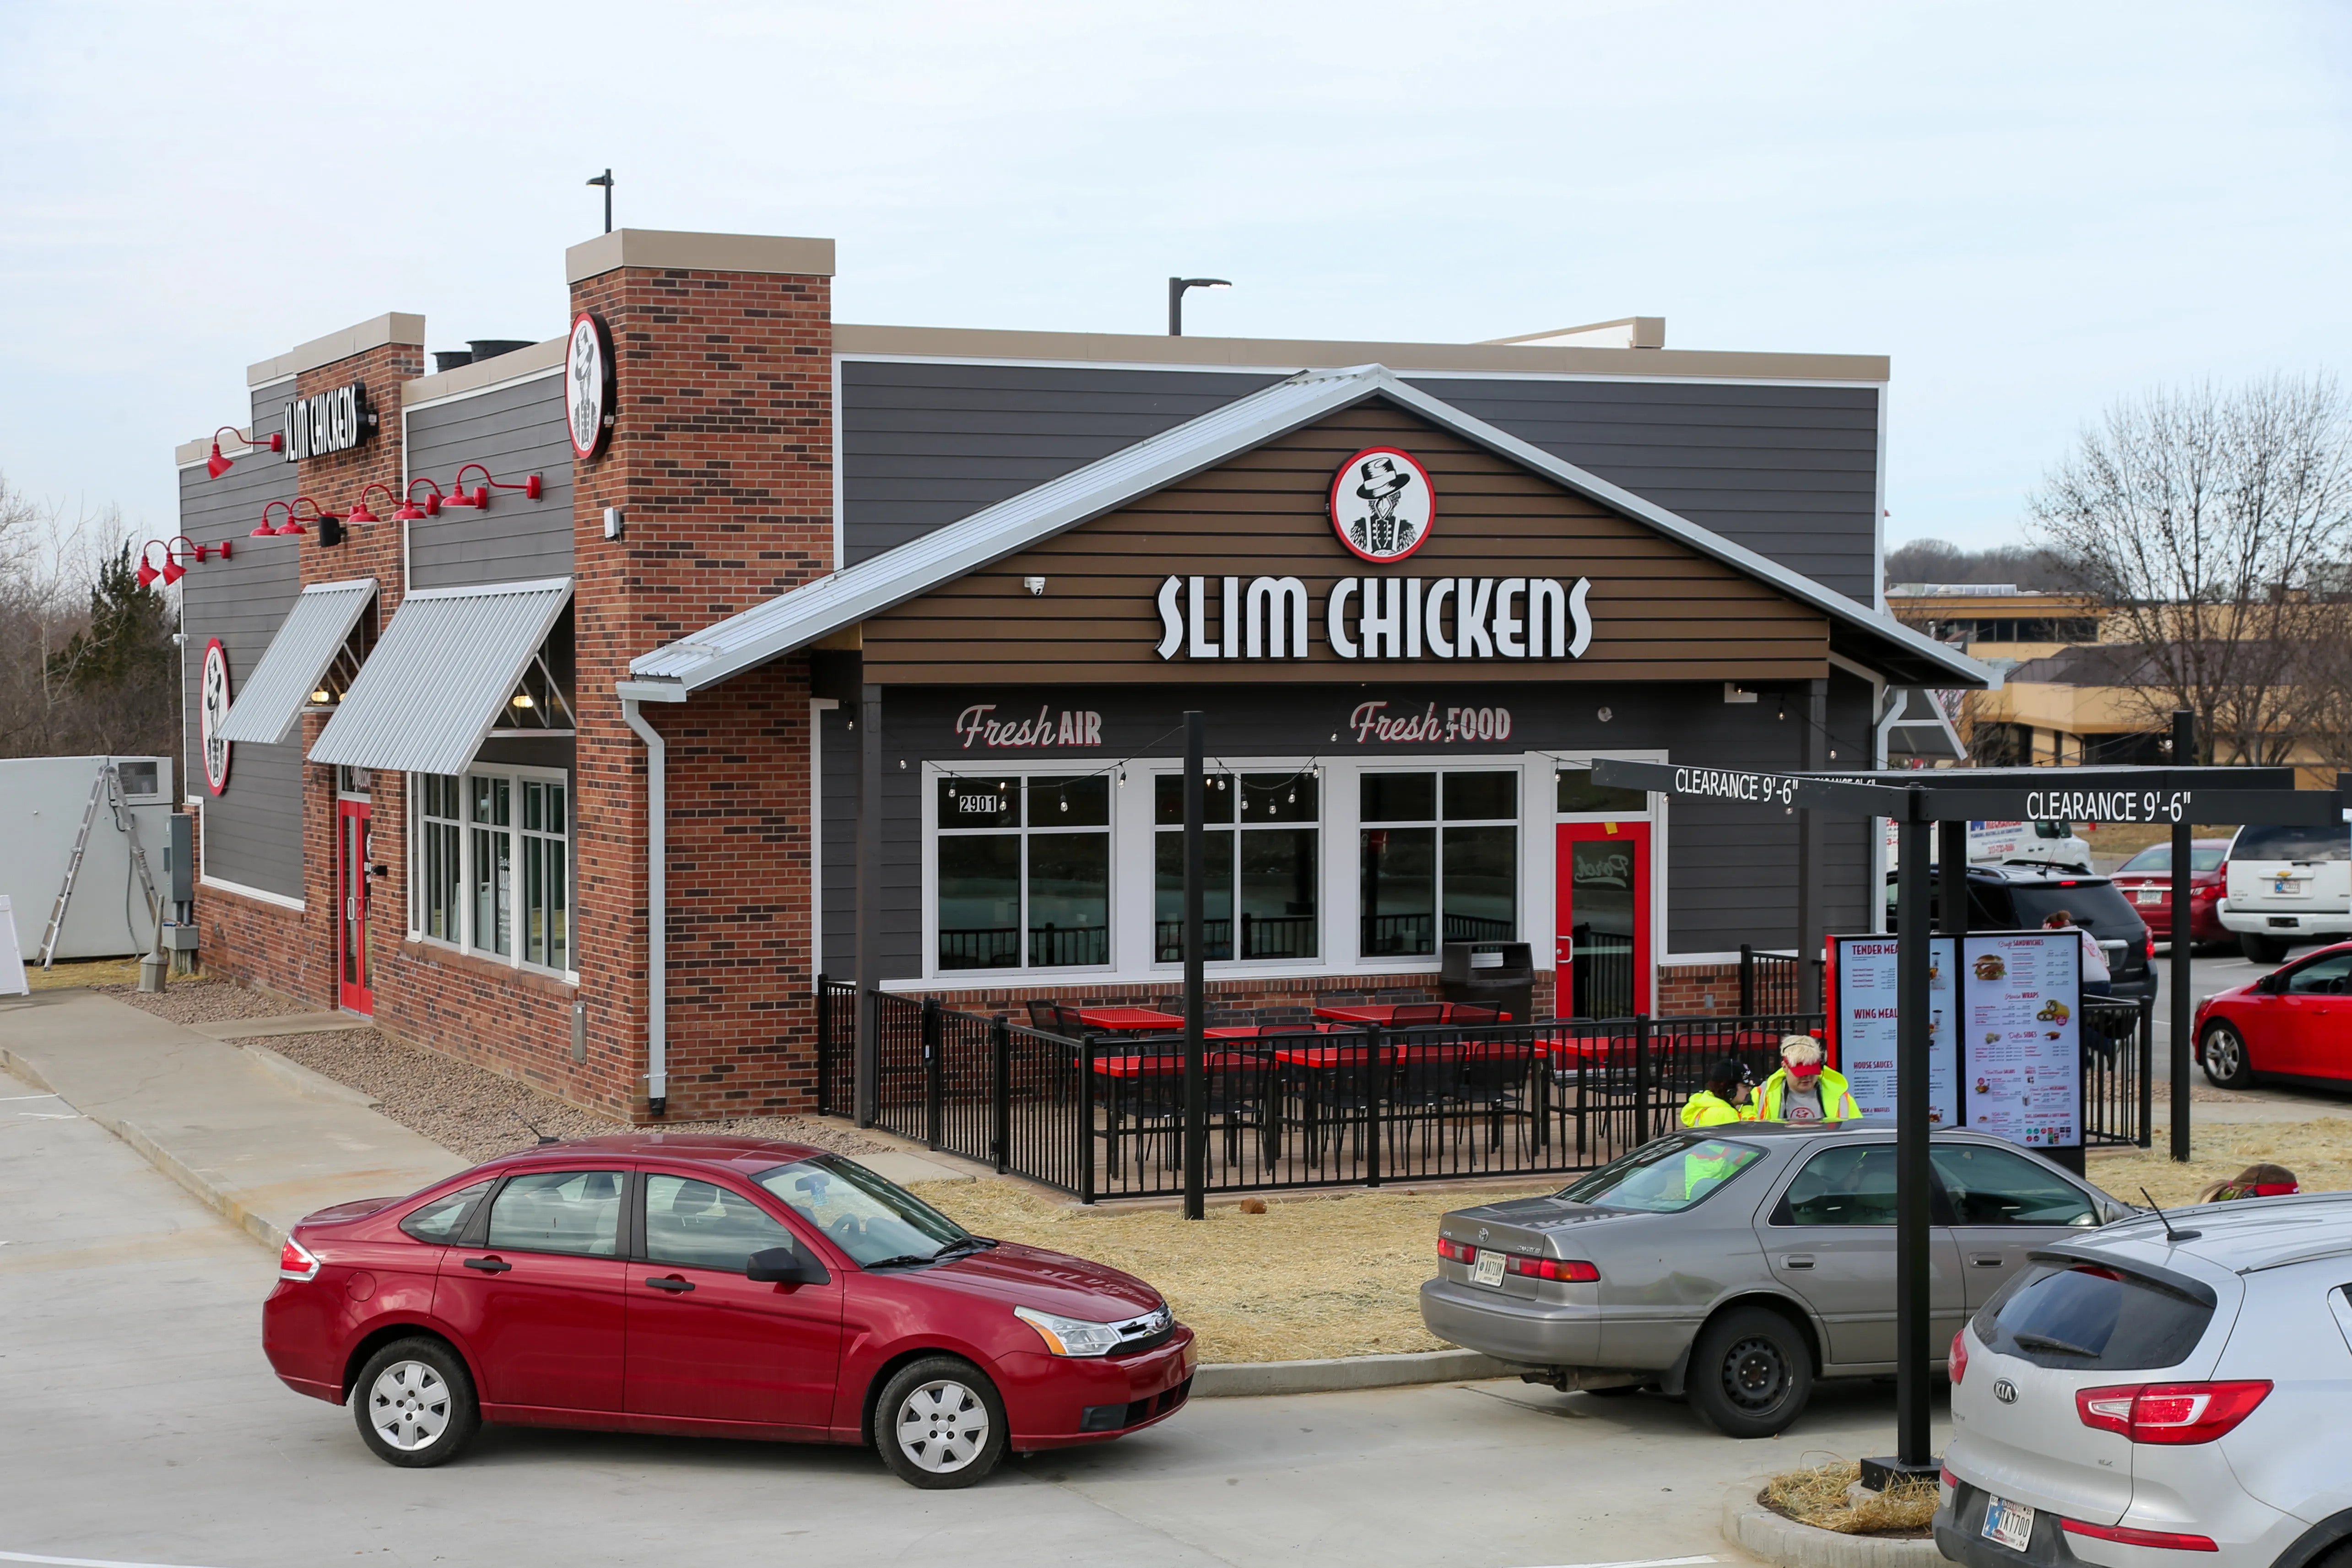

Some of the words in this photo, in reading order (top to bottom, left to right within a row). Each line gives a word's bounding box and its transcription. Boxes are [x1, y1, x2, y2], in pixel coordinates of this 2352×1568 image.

[285, 399, 308, 461] SLIM
[310, 384, 357, 456] CHICKENS
[1156, 574, 1308, 660] SLIM
[1328, 576, 1593, 659] CHICKENS
[956, 704, 1056, 748] Fresh
[1058, 711, 1102, 746] AIR
[1350, 701, 1442, 743] Fresh
[1446, 708, 1511, 741] FOOD
[1675, 768, 1758, 800] CLEARANCE
[961, 796, 994, 811] 2901
[2026, 791, 2137, 821] CLEARANCE
[1852, 945, 1882, 955] TENDER
[1854, 1008, 1876, 1019] WING
[1995, 1382, 2012, 1400] KIA
[2000, 1510, 2030, 1537] TXT700
